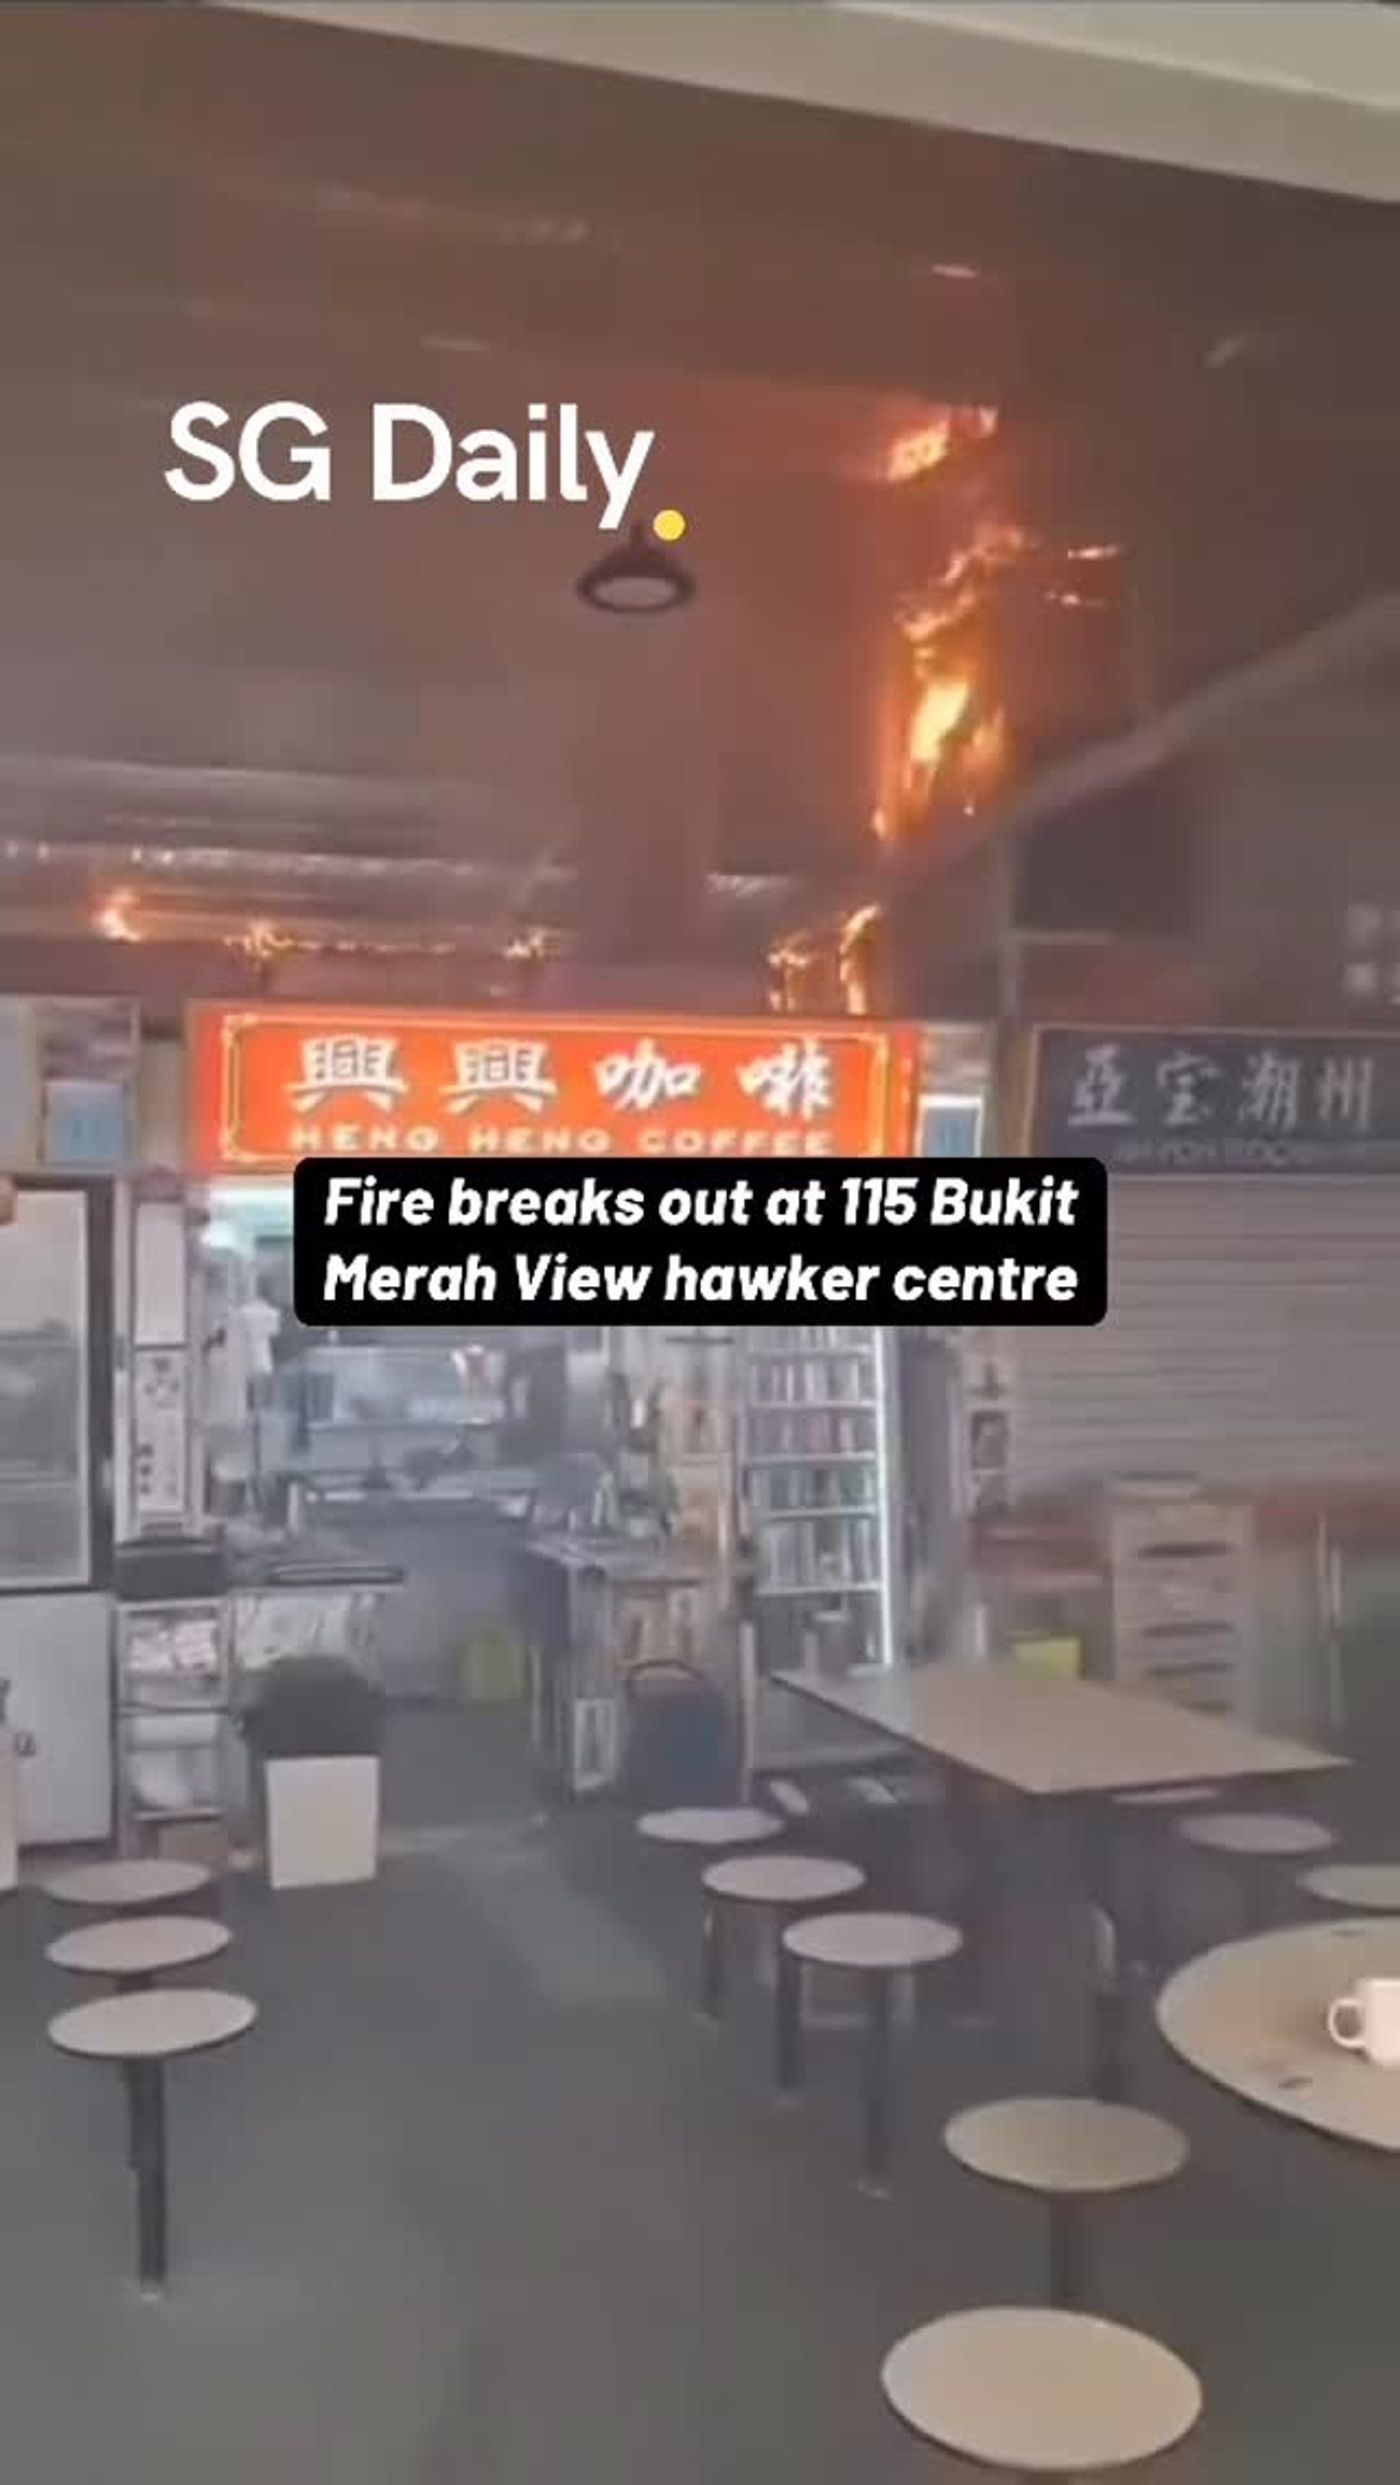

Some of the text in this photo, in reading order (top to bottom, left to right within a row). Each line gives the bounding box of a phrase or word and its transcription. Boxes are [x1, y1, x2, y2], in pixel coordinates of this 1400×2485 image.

[287, 1033, 833, 1120] 興興咖啡
[292, 1124, 831, 1157] HENG HENG COFFEE
